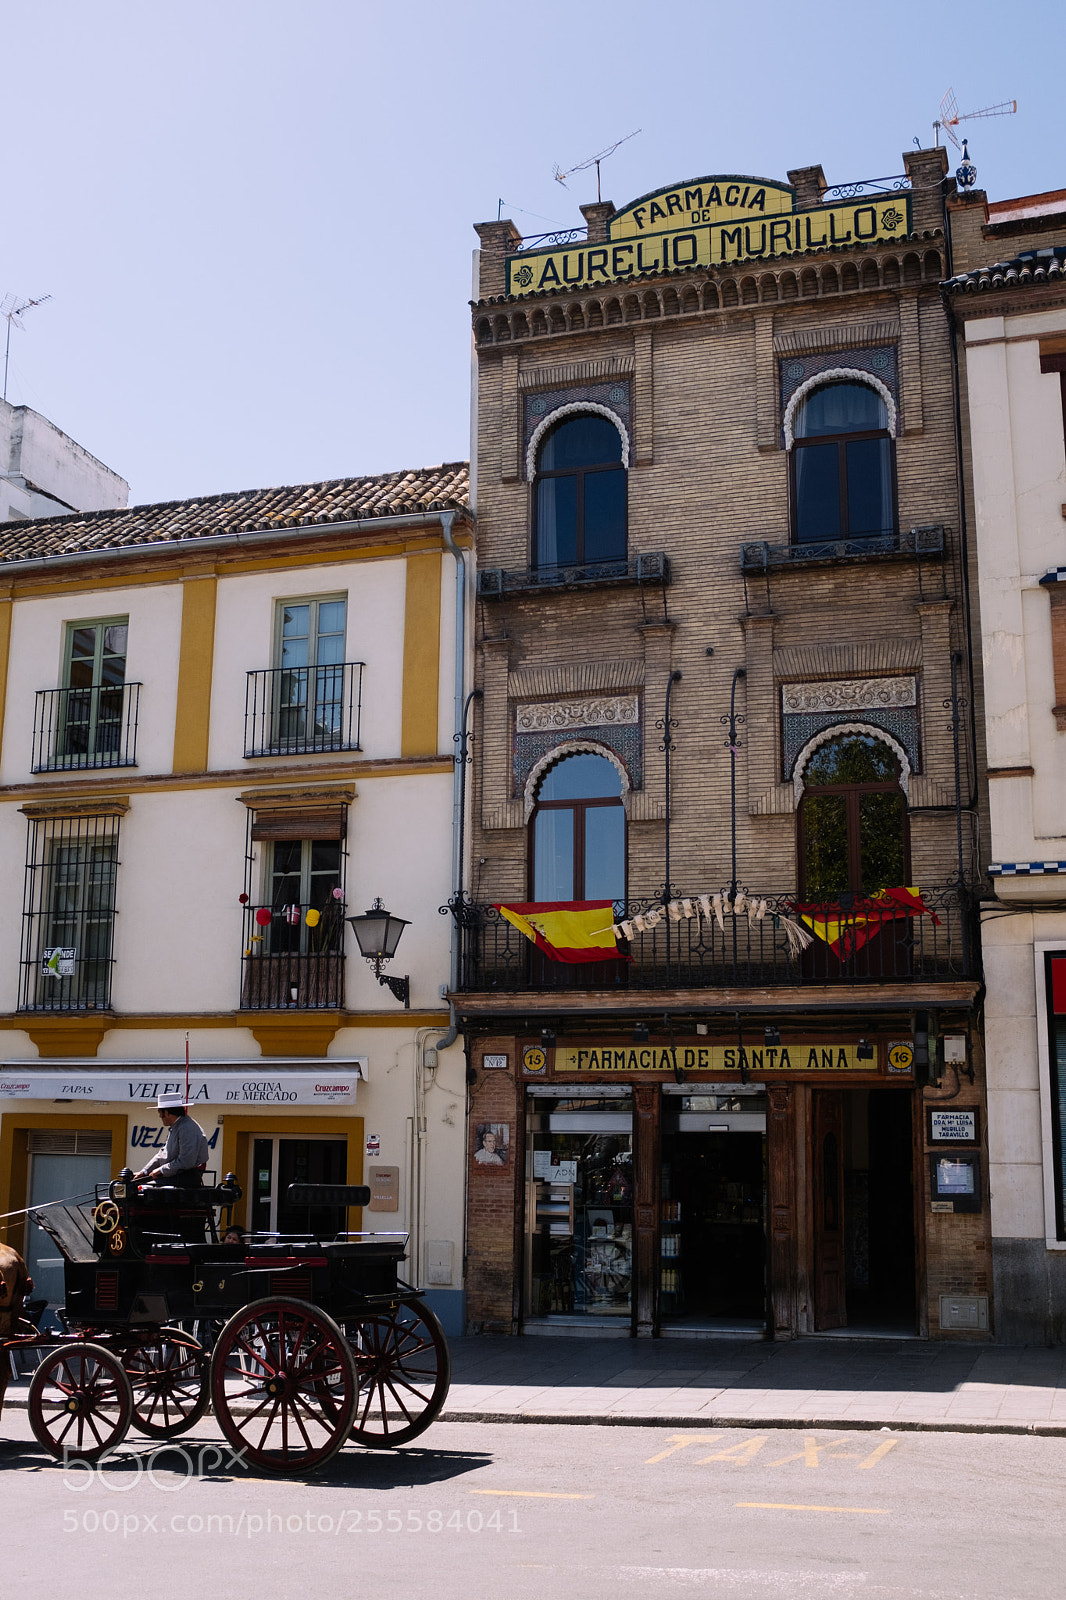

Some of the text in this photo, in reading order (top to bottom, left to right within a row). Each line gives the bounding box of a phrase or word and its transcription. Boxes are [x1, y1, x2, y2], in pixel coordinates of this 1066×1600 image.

[632, 183, 766, 229] FARMACIA
[691, 210, 710, 224] DE
[538, 206, 877, 287] AURELIO MURILLO
[528, 1054, 542, 1065] 15
[577, 1048, 848, 1069] FARMACIA DE SANTA ANA
[893, 1051, 908, 1063] 16
[62, 1086, 94, 1094] TAPAS
[128, 1083, 210, 1099] VELELLA
[242, 1082, 282, 1091] COCINA
[315, 1084, 349, 1092] Cruzcampo
[226, 1091, 298, 1101] DE MERCADO
[131, 1126, 220, 1149] VELA
[645, 1434, 898, 1469] TAXI
